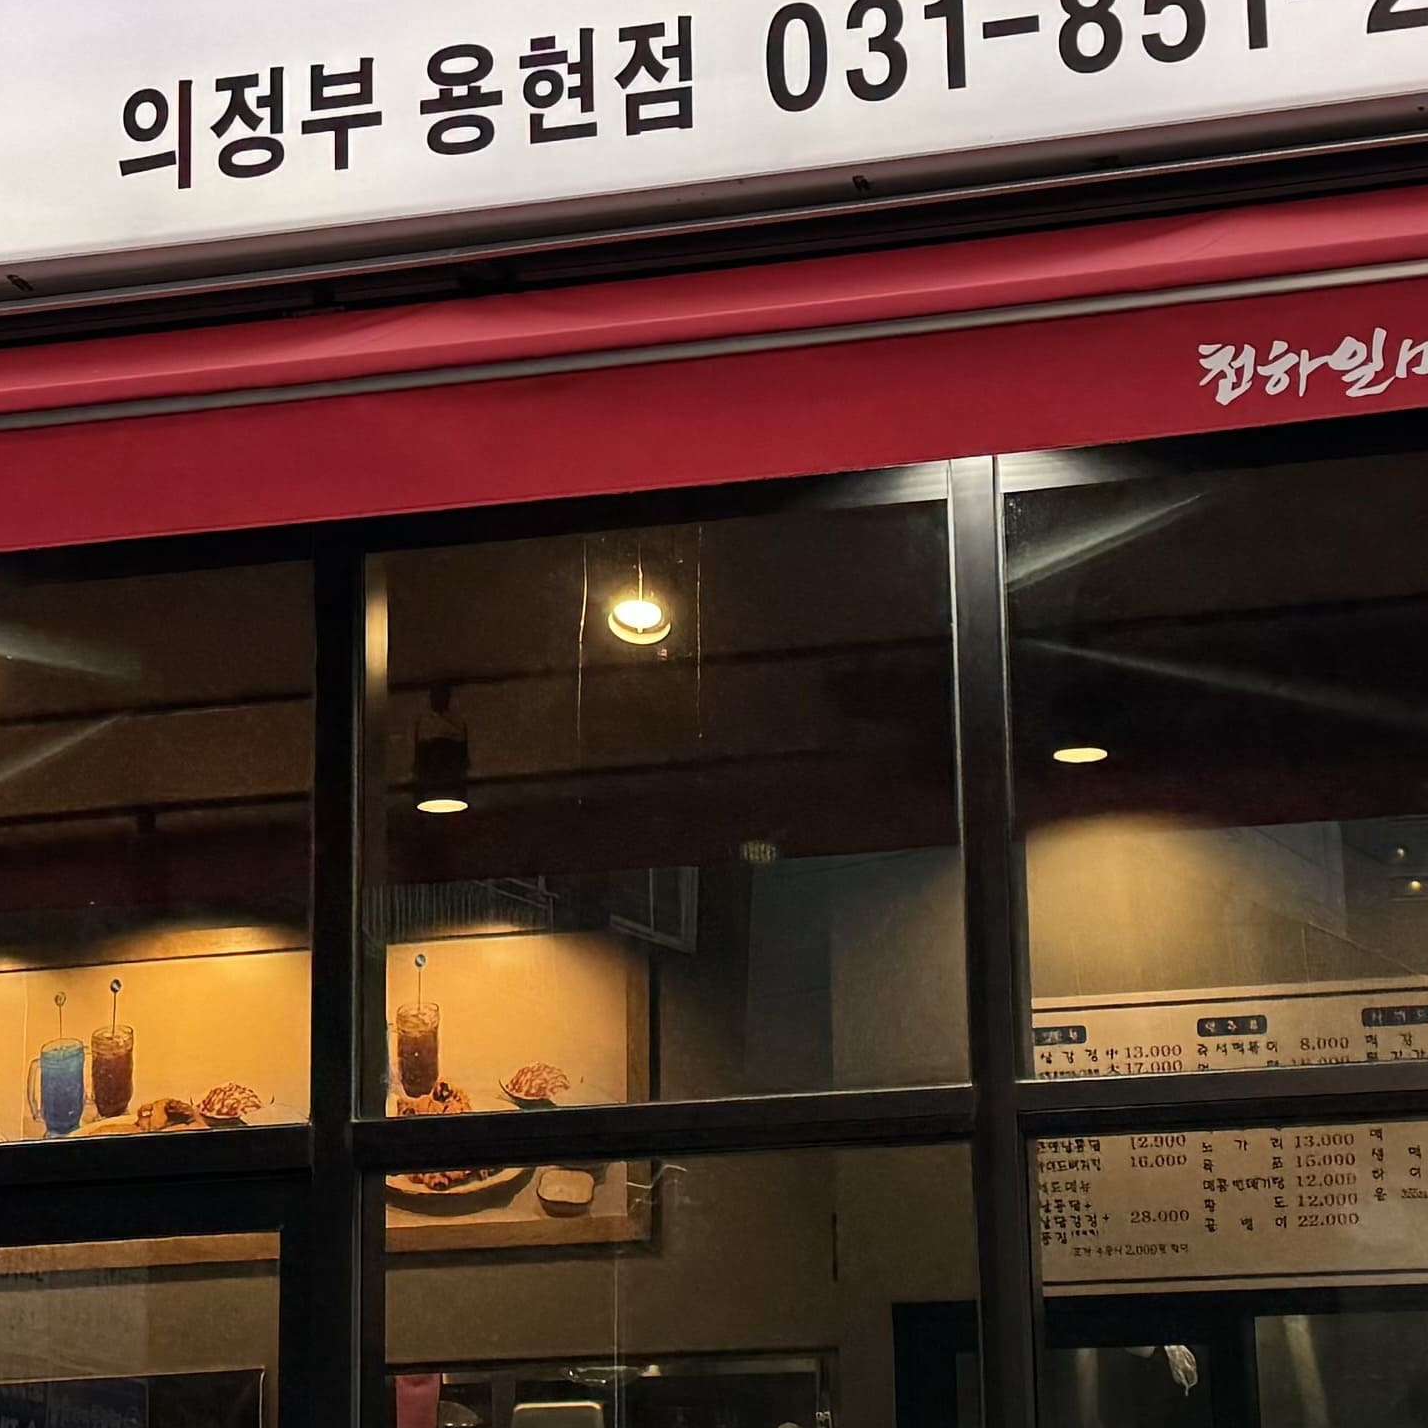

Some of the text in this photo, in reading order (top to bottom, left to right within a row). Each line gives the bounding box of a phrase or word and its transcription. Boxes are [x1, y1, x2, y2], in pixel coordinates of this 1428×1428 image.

[119, 57, 382, 190] 의정부
[419, 15, 693, 155] 용현점
[1295, 1133, 1355, 1149] 13.000
[1297, 1172, 1357, 1187] 12.000
[1298, 1192, 1358, 1208] 12.000
[1130, 1209, 1190, 1224] 28.000
[1298, 1212, 1360, 1228] 22.000
